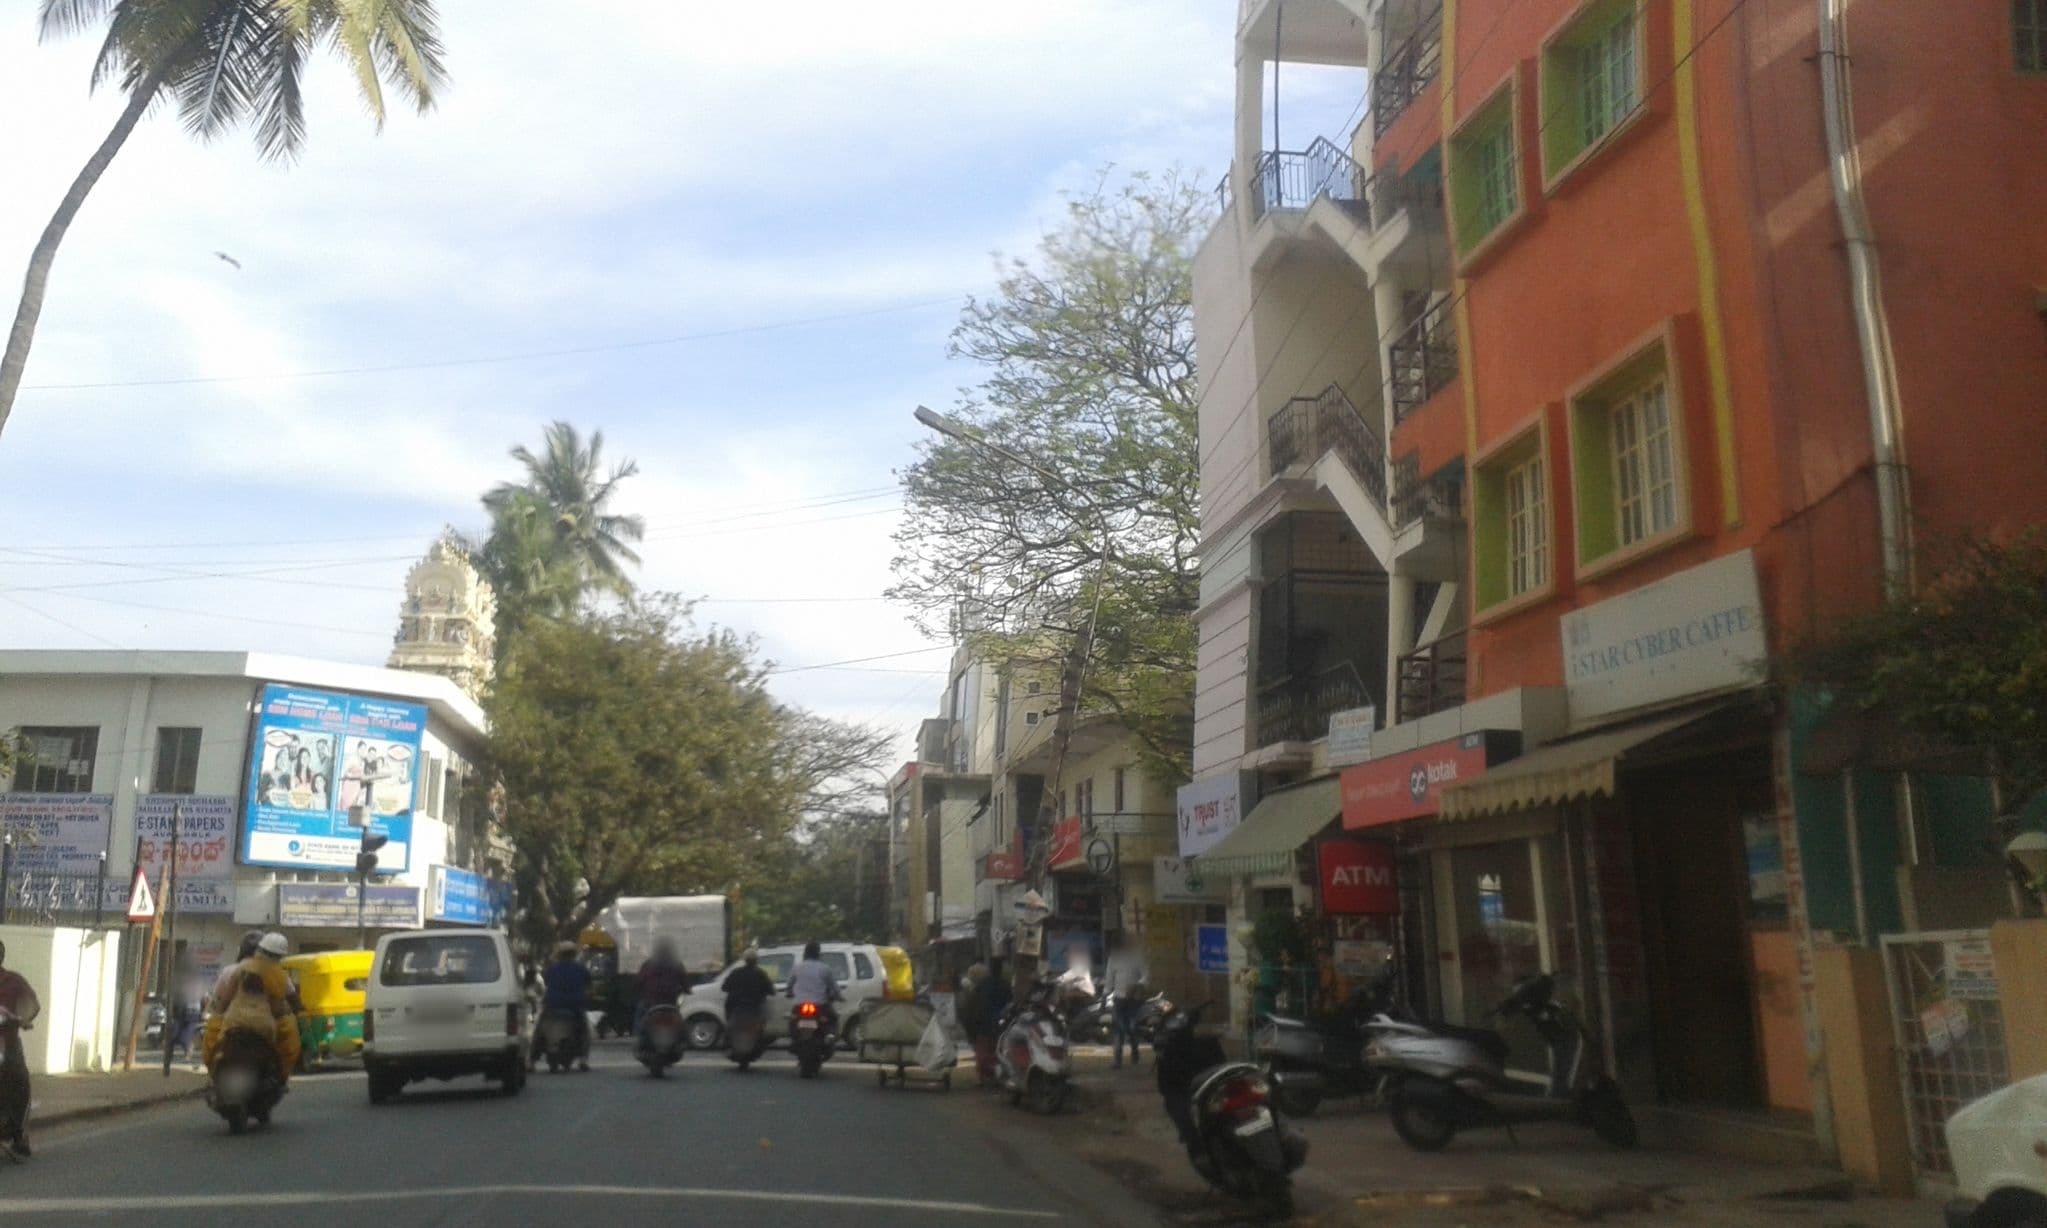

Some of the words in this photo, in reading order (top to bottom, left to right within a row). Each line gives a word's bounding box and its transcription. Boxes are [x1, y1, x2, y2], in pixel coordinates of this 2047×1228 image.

[1623, 627, 1682, 667] CYBER
[1686, 606, 1752, 648] CAFFE
[1427, 760, 1458, 784] kotak
[138, 816, 179, 830] E-STAM
[184, 817, 225, 831] PAPERS
[1194, 800, 1220, 825] TRUST
[1332, 866, 1391, 887] ATM
